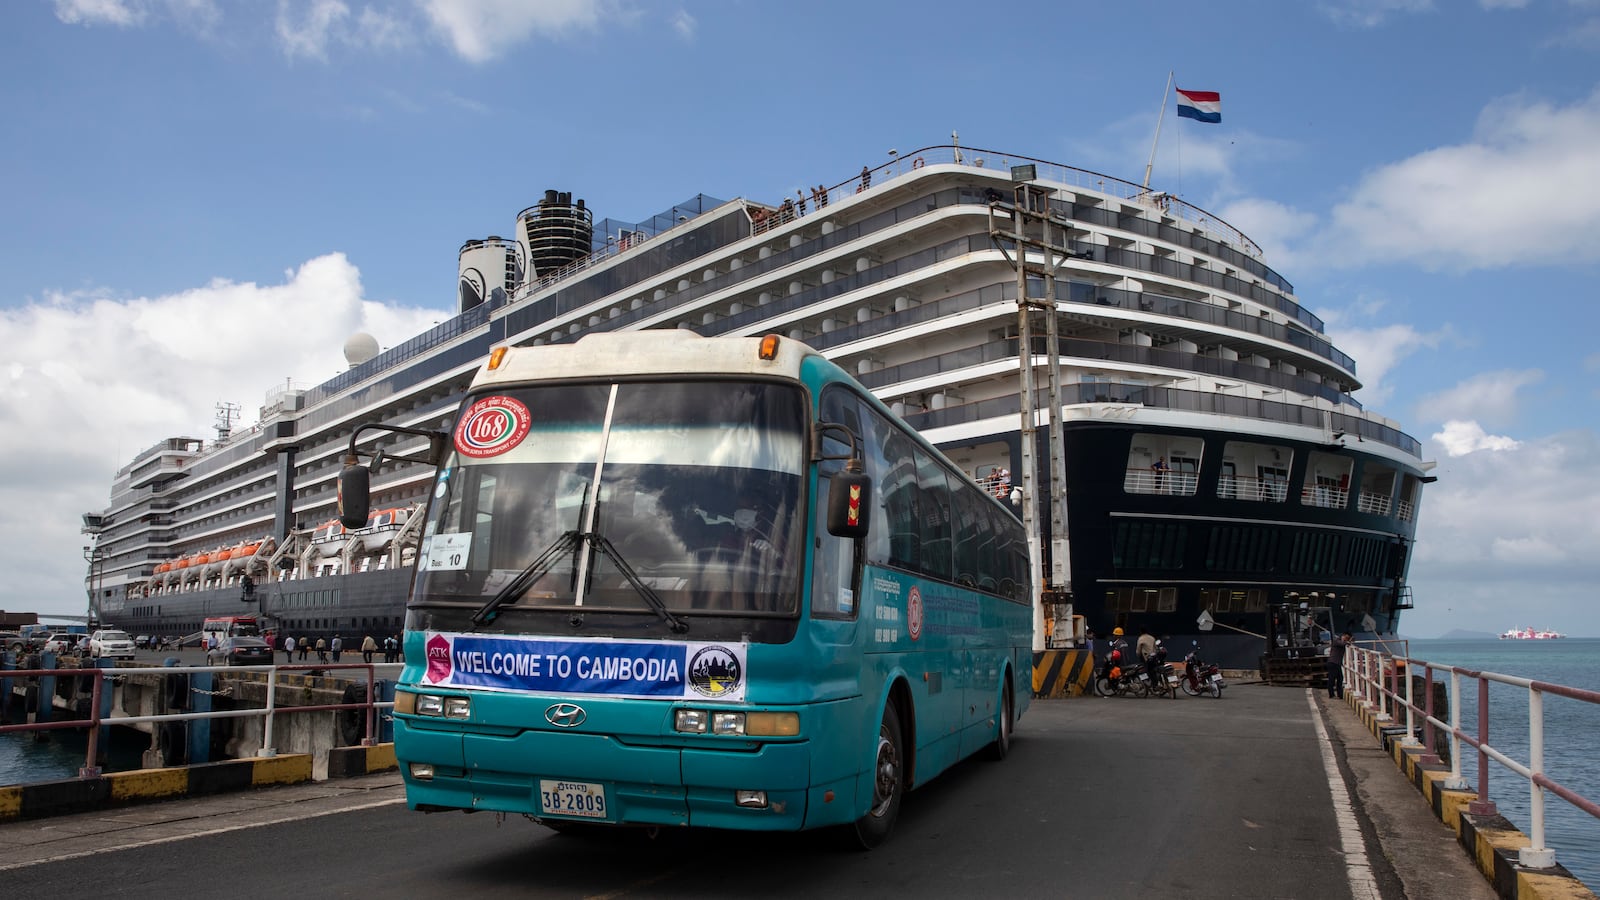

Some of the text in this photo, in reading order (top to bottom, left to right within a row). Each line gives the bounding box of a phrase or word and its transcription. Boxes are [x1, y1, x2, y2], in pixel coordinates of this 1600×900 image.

[473, 414, 505, 438] 168
[483, 444, 510, 455] TRANSPORT
[450, 554, 461, 566] 10
[429, 647, 448, 658] ATK
[456, 650, 540, 677] WELCOME
[546, 655, 571, 678] TO
[577, 656, 680, 682] CAMBODIA
[543, 792, 604, 811] 3B-2809
